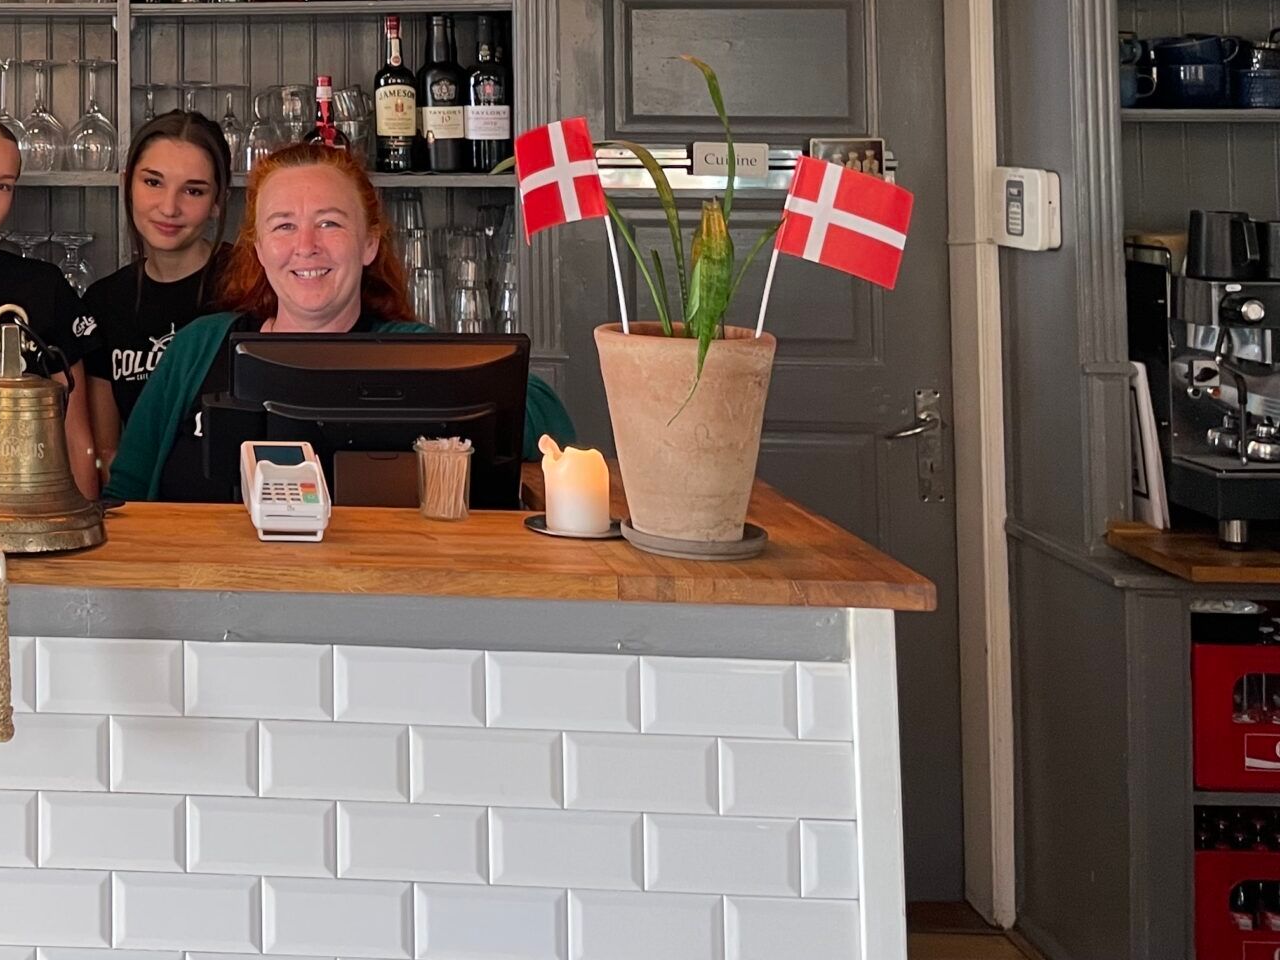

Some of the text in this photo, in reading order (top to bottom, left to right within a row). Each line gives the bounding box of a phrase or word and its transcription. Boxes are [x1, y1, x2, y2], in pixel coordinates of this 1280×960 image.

[379, 89, 415, 100] JAMESON
[704, 153, 757, 167] Cuiine
[111, 349, 163, 381] COLU
